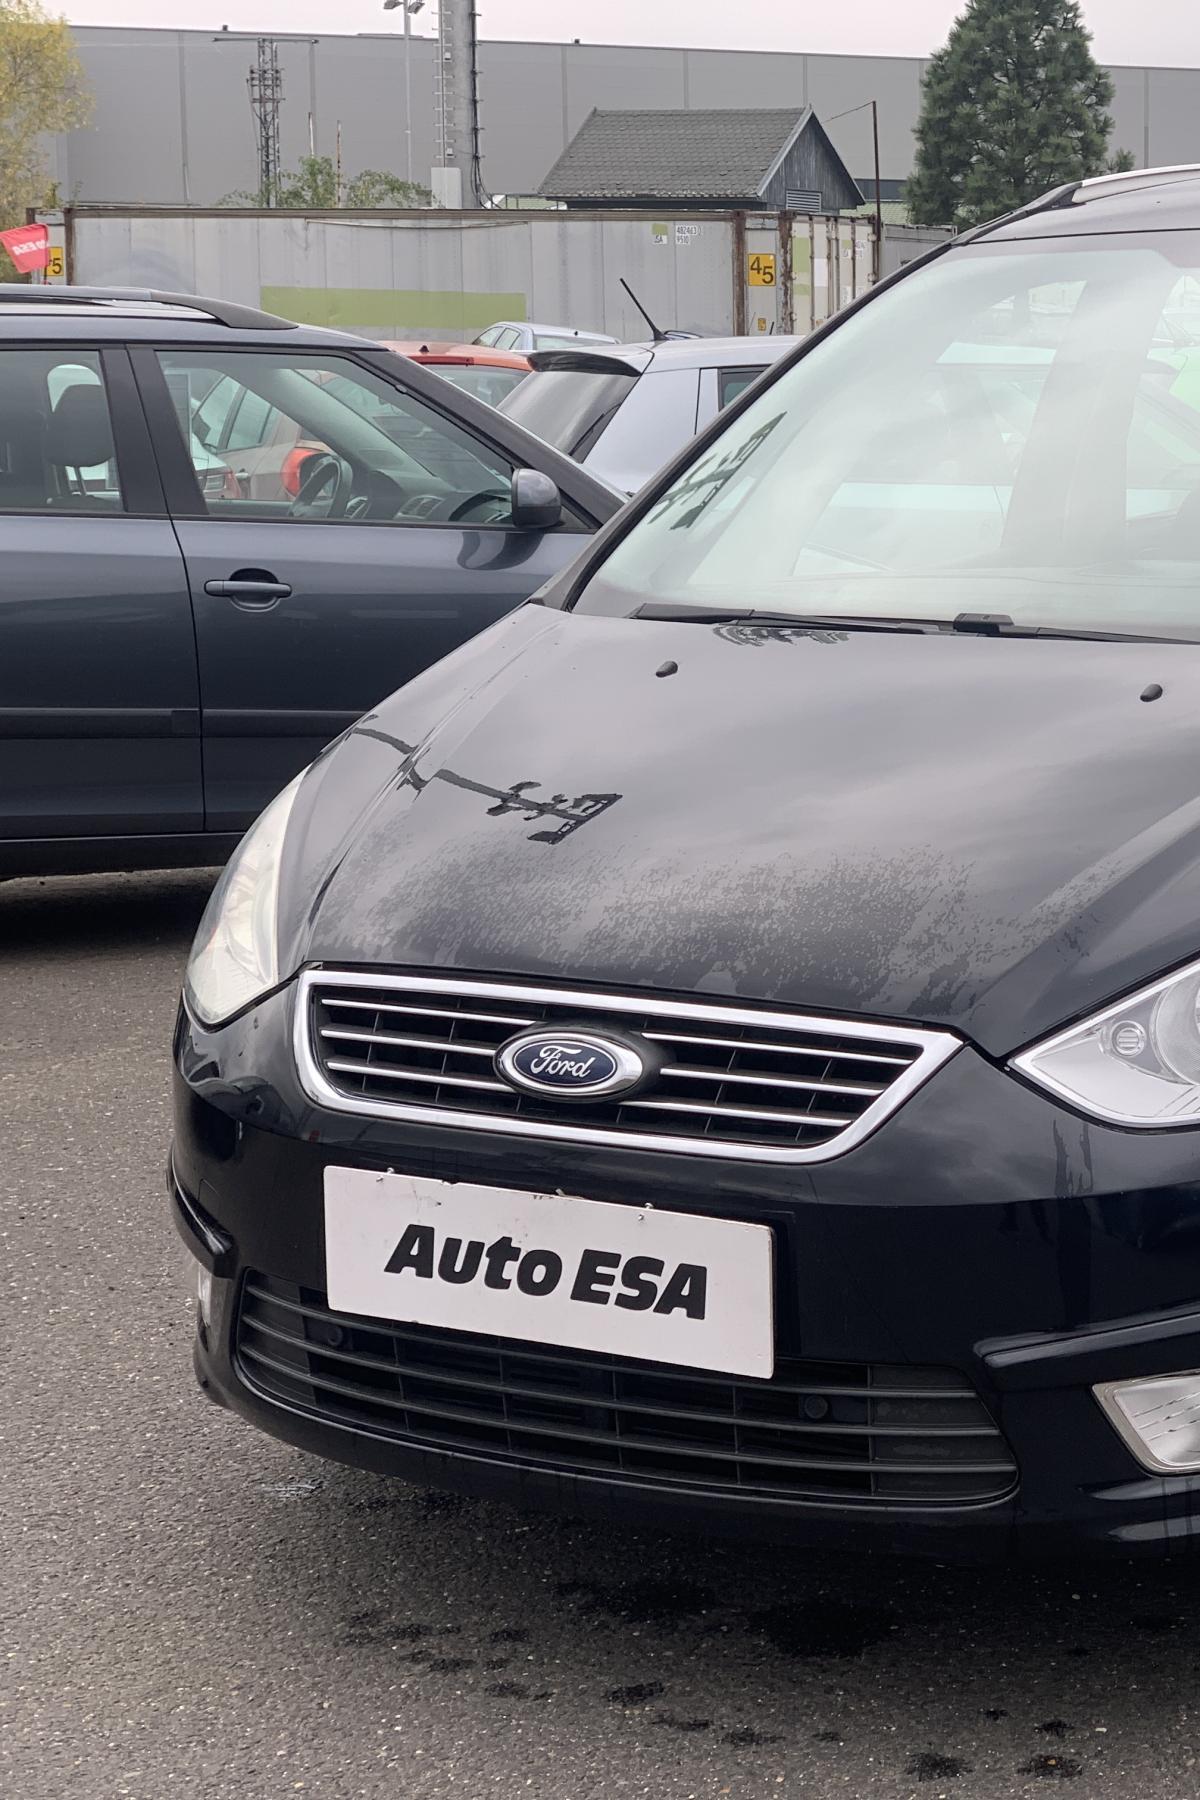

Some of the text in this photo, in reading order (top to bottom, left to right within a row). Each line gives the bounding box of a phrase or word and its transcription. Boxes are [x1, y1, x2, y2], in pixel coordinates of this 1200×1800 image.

[750, 256, 774, 284] 45
[530, 1045, 596, 1078] Ford
[384, 1223, 708, 1320] Auto ESA
